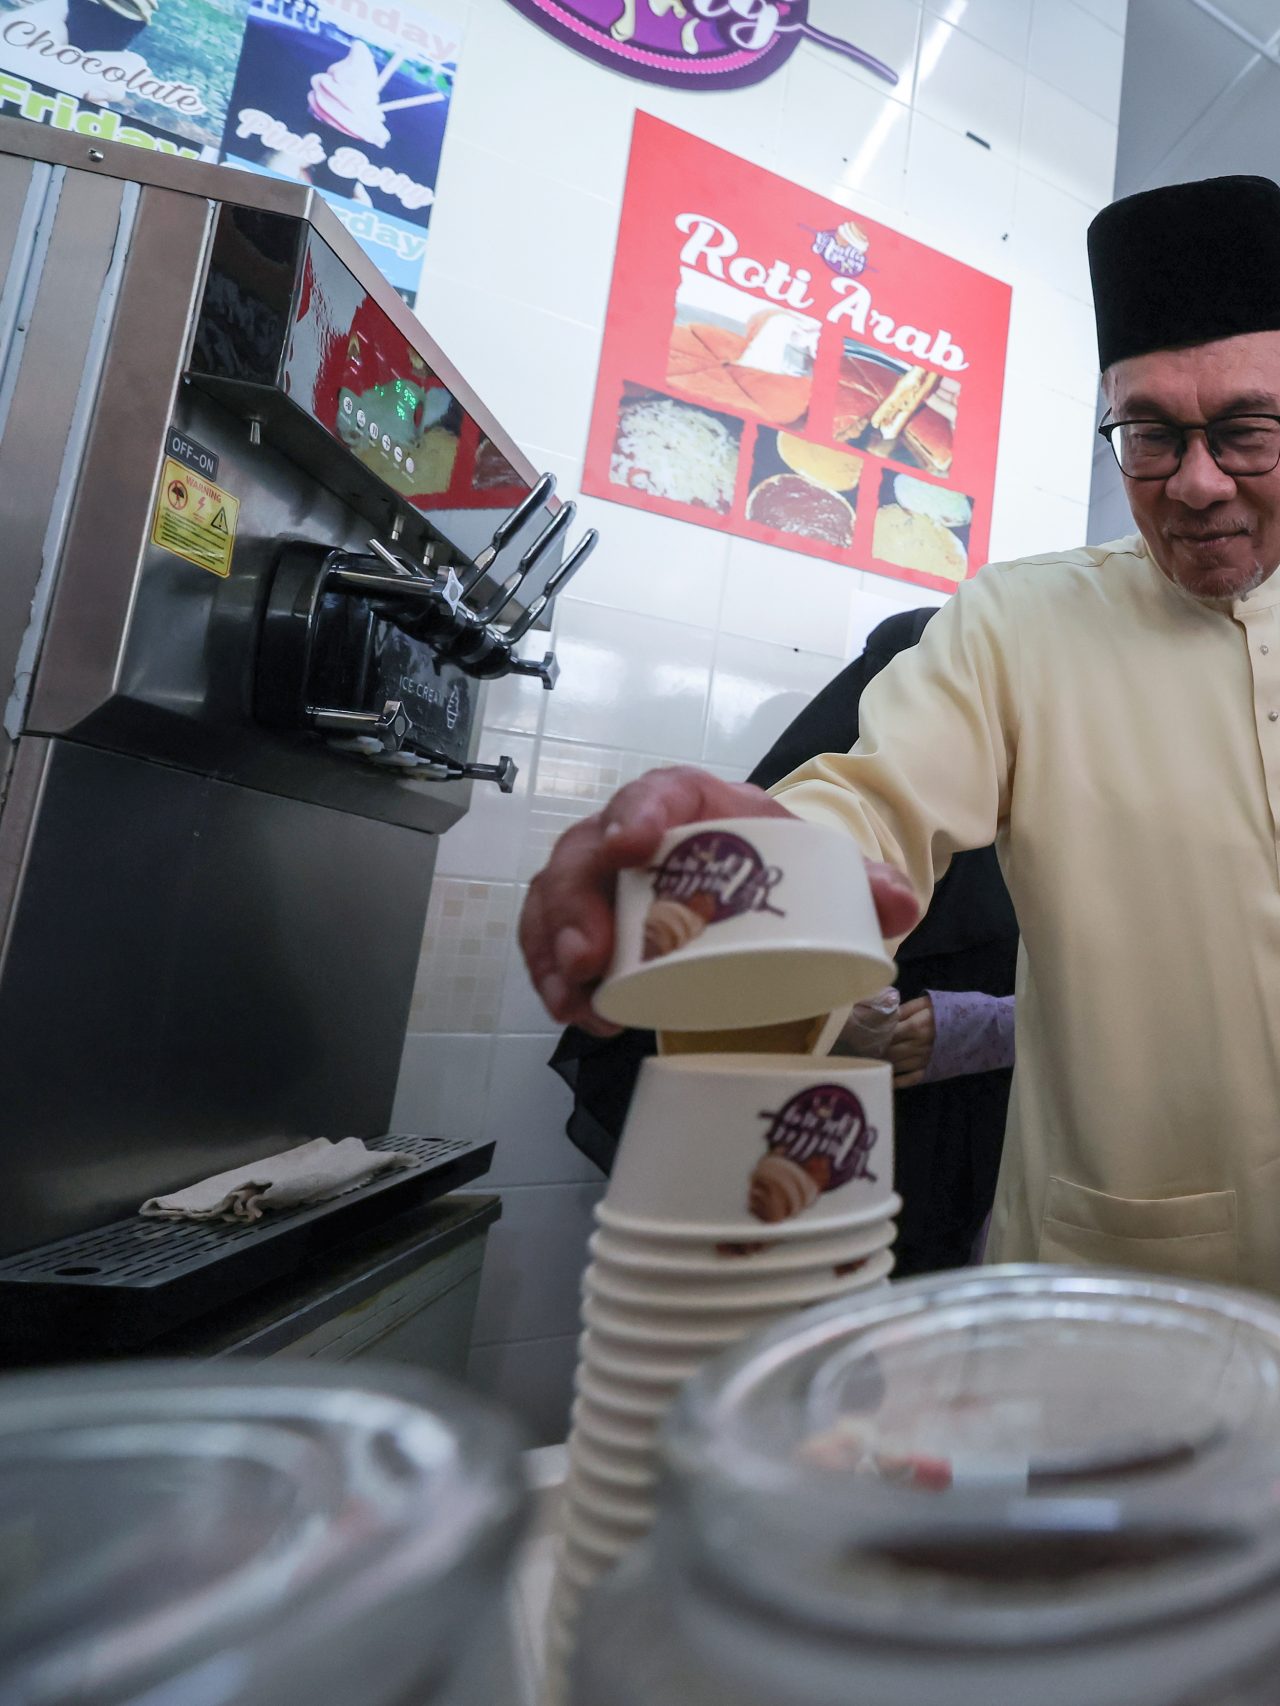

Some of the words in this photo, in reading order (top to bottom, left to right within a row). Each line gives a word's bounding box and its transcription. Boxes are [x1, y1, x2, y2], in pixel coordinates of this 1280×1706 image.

[3, 20, 203, 112] Chocolate
[675, 213, 814, 308] Roti
[827, 277, 969, 371] Arab
[172, 437, 214, 473] OFF-ON
[185, 475, 222, 504] WARNING
